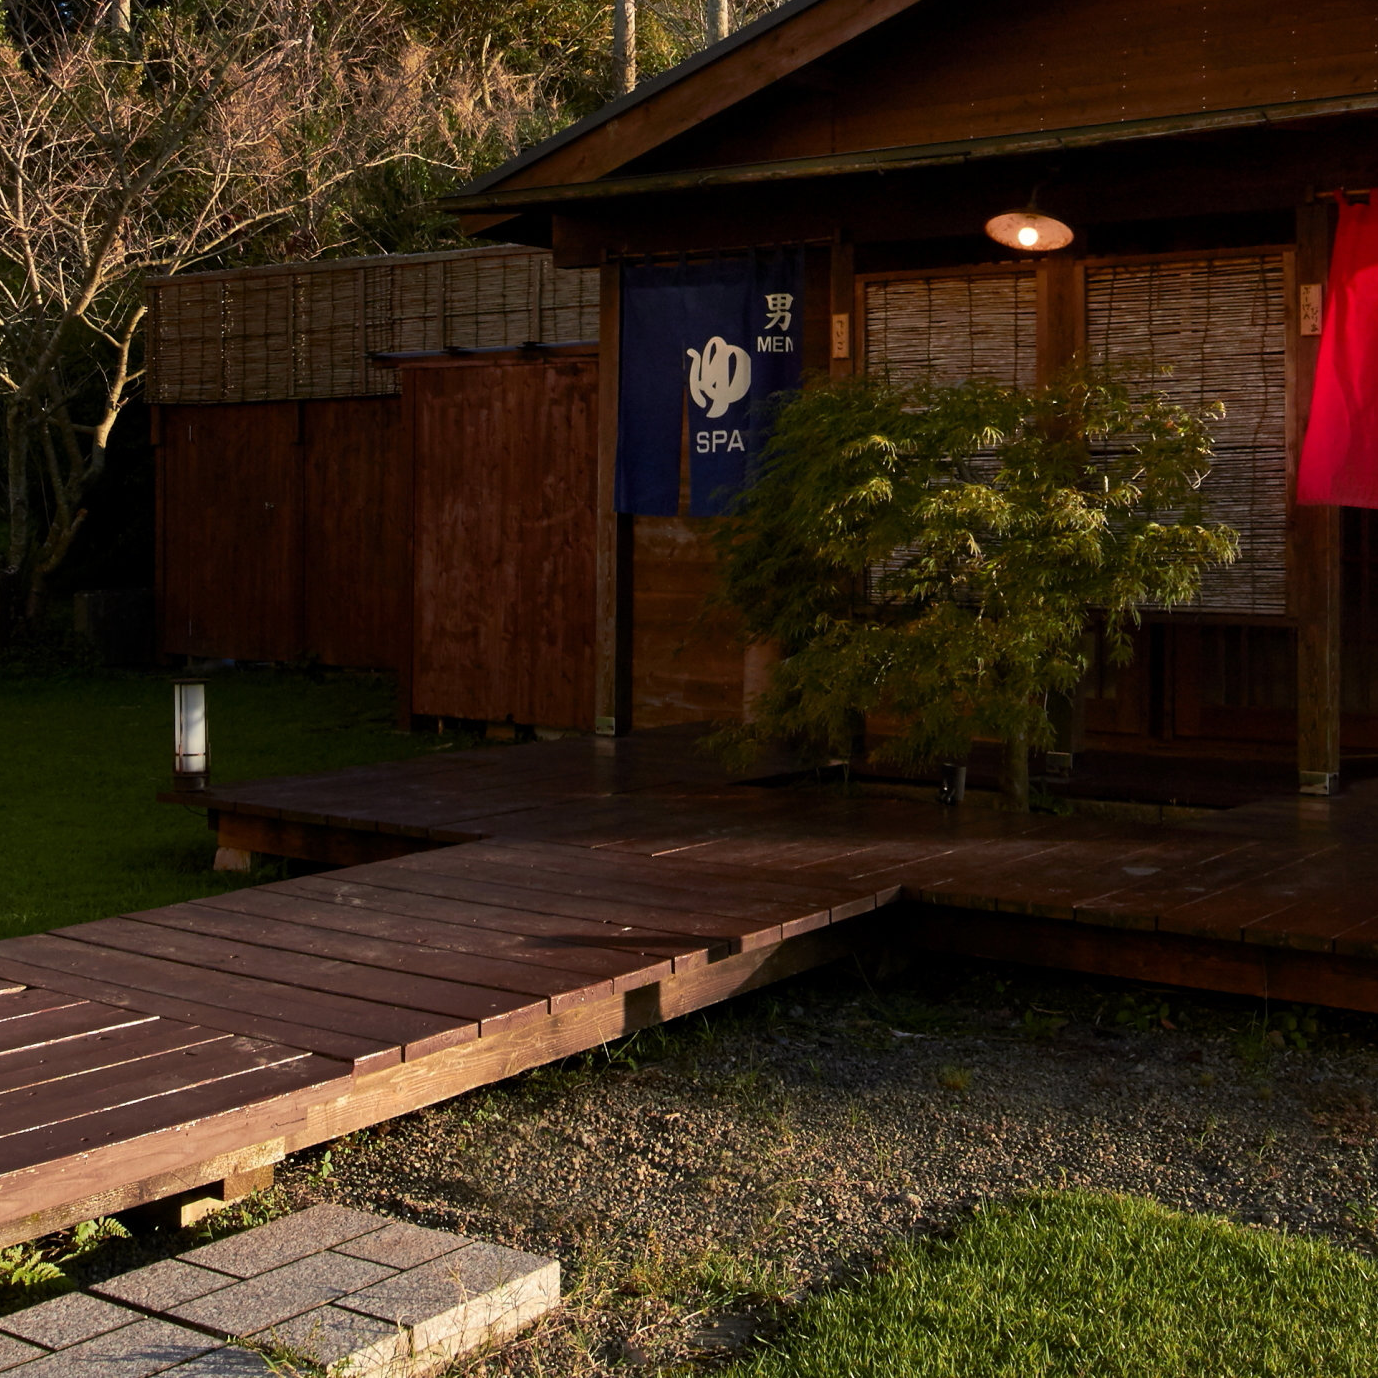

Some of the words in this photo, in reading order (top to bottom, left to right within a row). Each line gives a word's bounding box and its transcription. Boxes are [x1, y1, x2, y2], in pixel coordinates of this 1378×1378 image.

[764, 292, 793, 332] 男
[757, 335, 793, 353] MEN
[686, 335, 751, 419] ゆ
[696, 429, 745, 454] SPA
